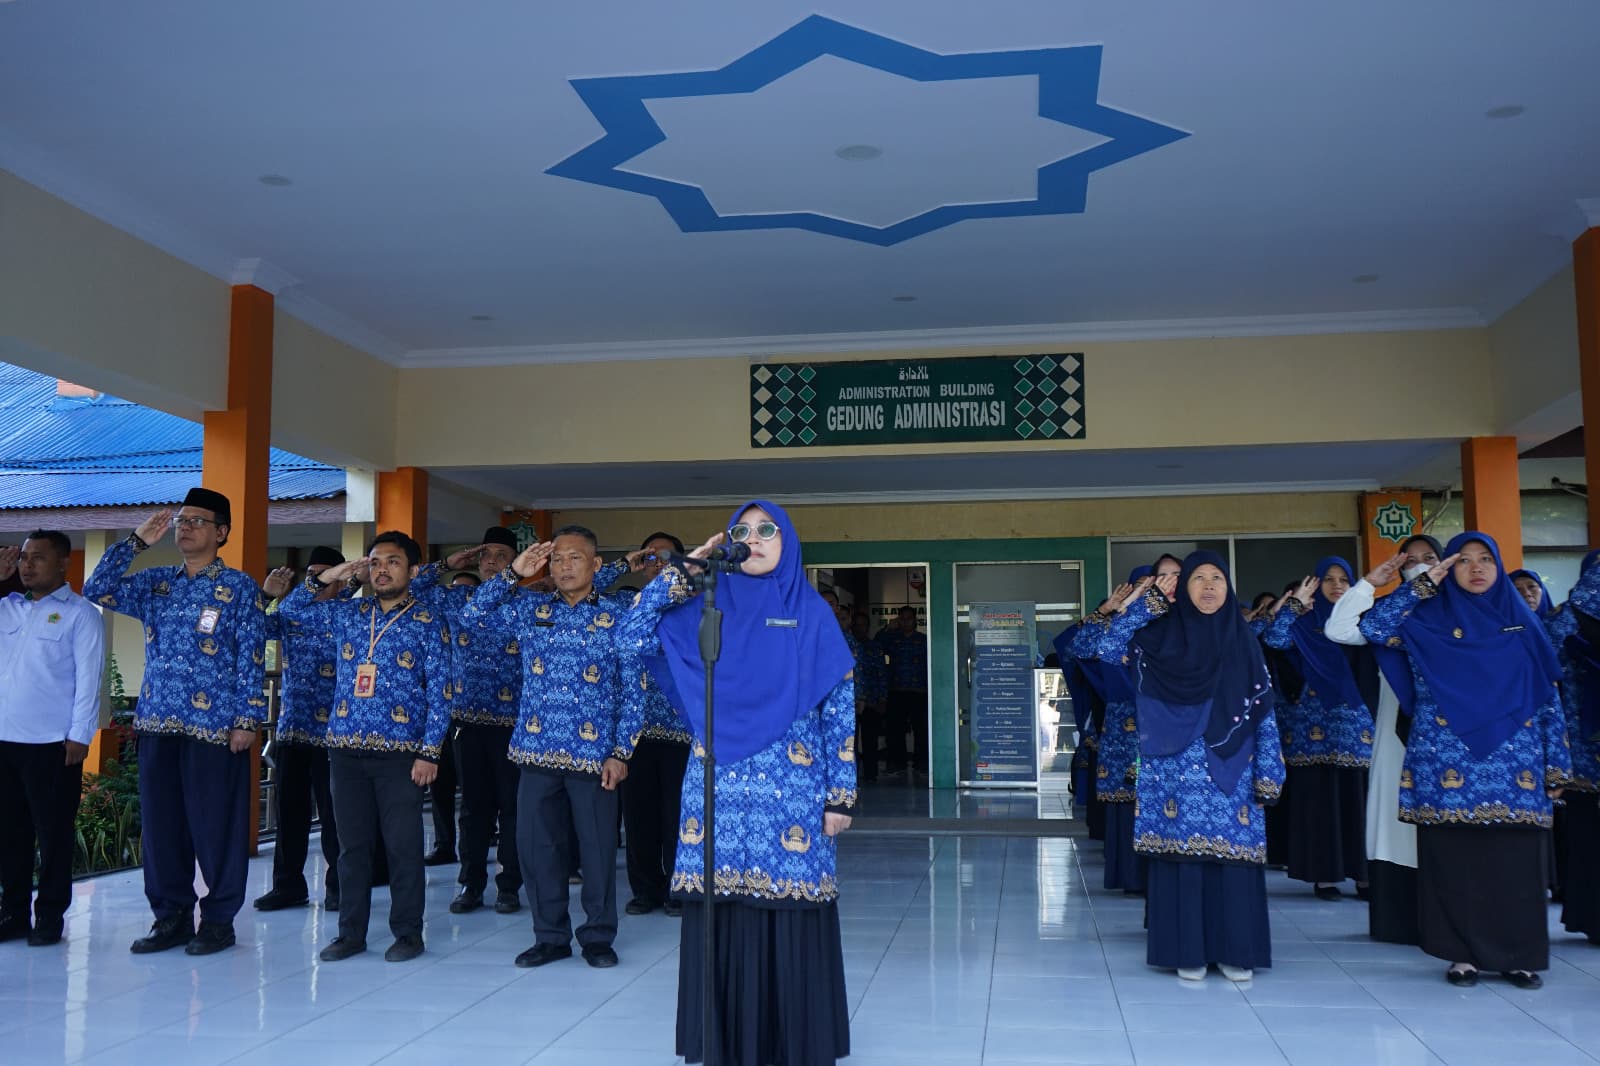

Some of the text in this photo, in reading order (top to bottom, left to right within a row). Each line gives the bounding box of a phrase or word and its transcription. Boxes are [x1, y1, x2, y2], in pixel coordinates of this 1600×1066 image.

[838, 383, 995, 400] ADMINISTRATION BUILDING
[826, 400, 1006, 431] GEDUNG ADMINISTRASI
